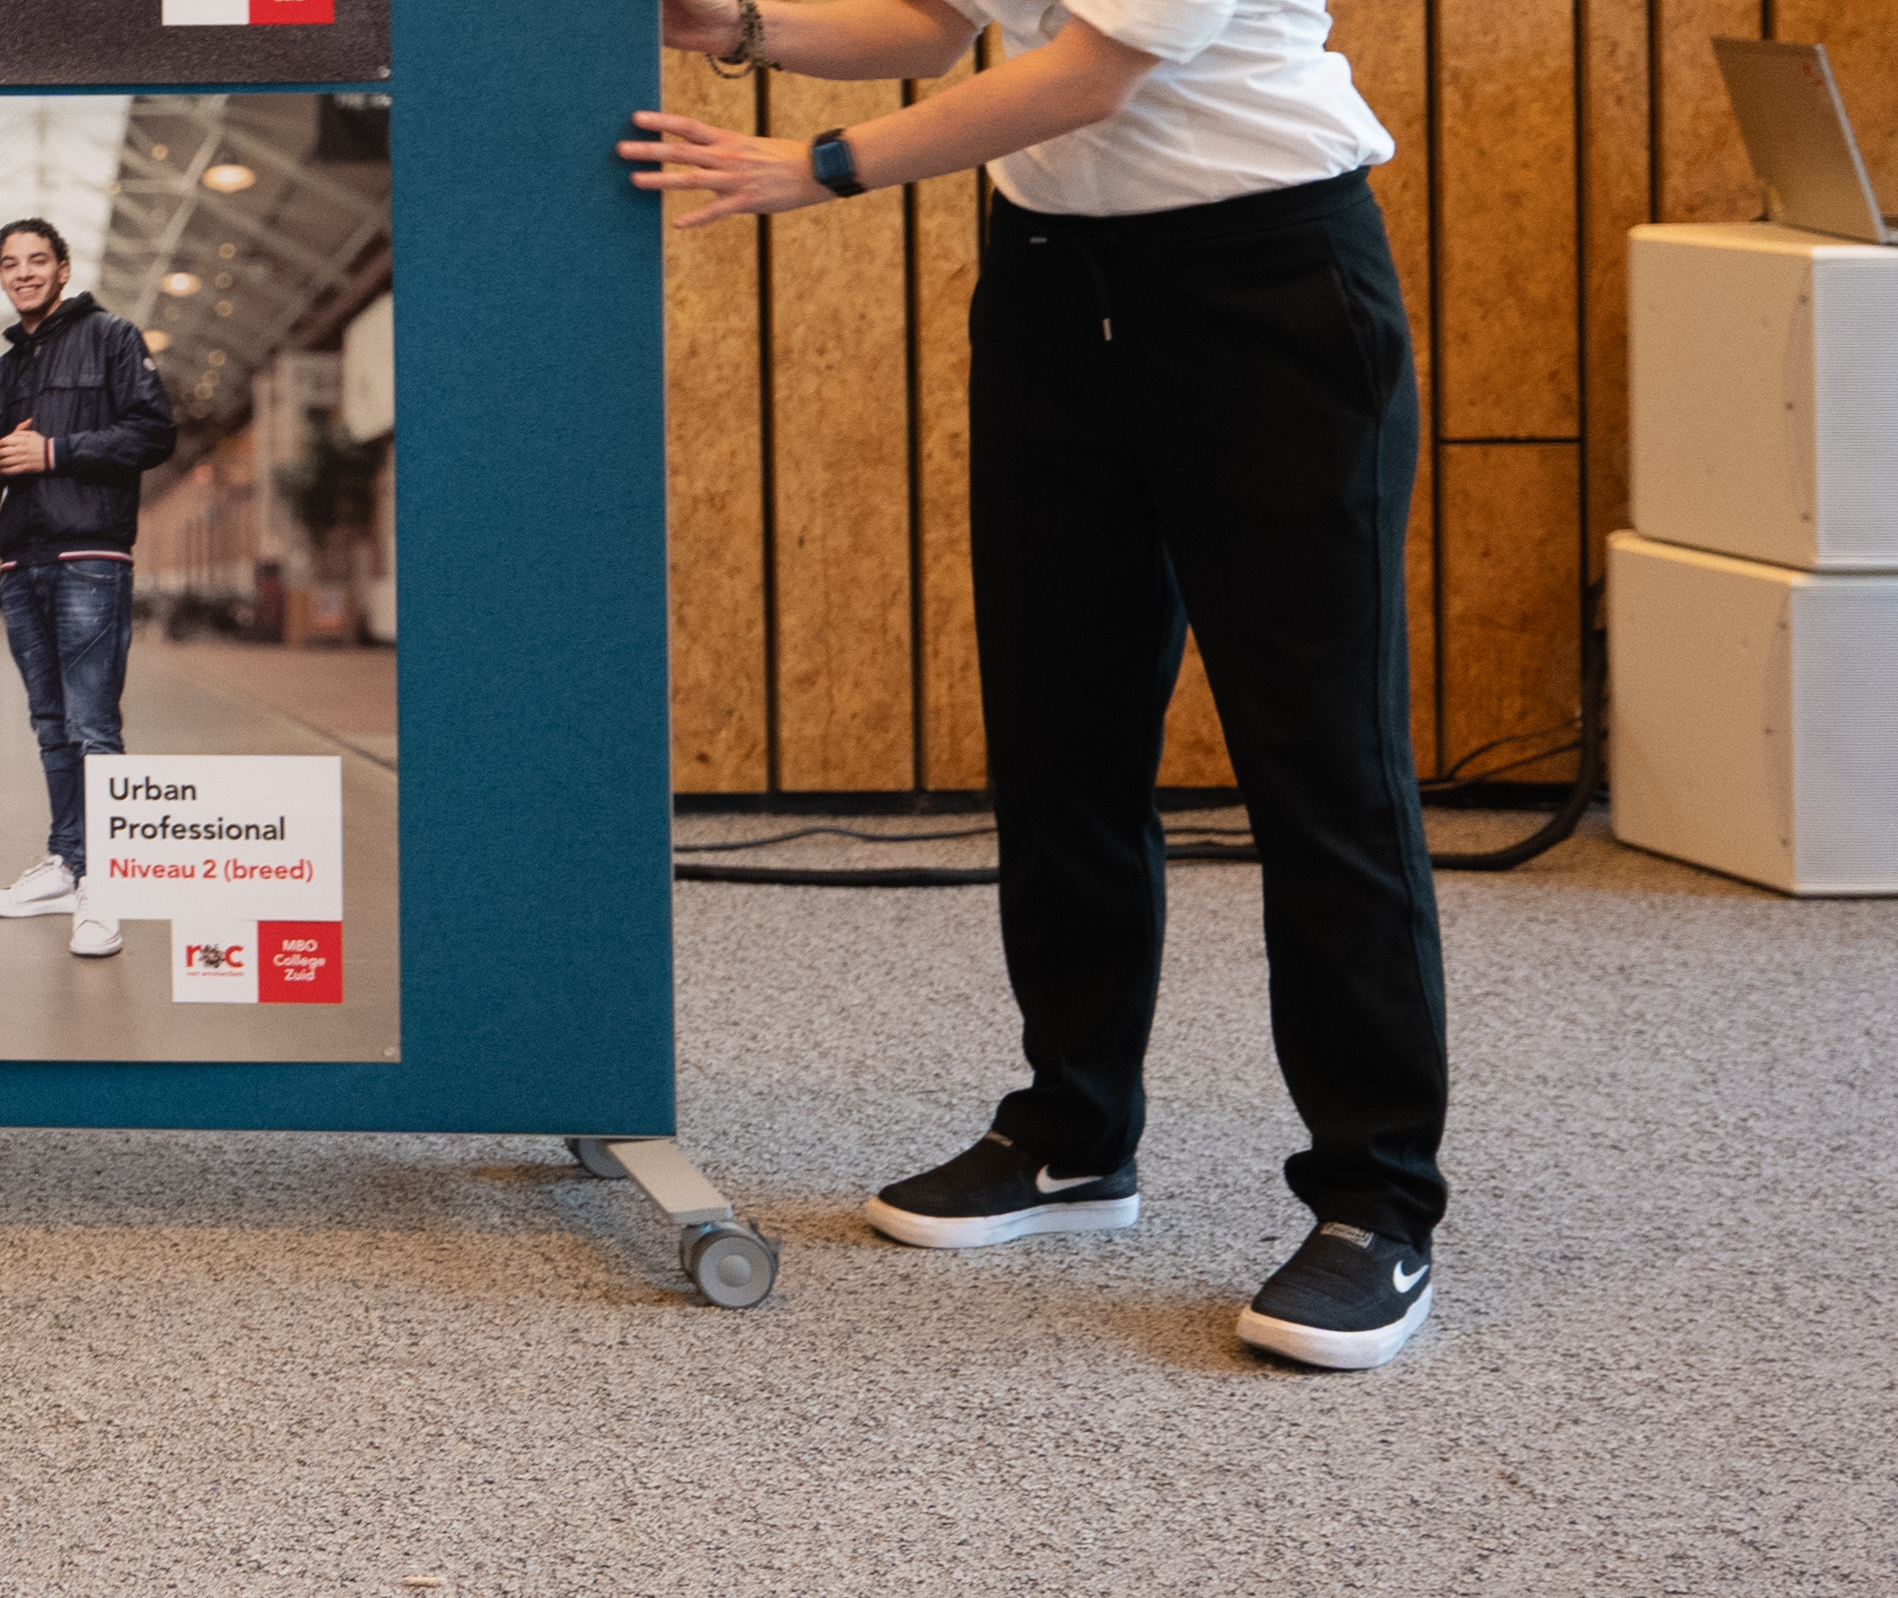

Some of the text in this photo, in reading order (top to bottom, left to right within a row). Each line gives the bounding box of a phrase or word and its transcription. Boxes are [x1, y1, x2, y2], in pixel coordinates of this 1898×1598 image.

[110, 776, 196, 800] Urban
[110, 815, 284, 840] Professional
[110, 858, 313, 883] Niveau 2 (breed)
[282, 940, 318, 952] MBO
[272, 953, 326, 971] College
[283, 968, 315, 981] Zuid
